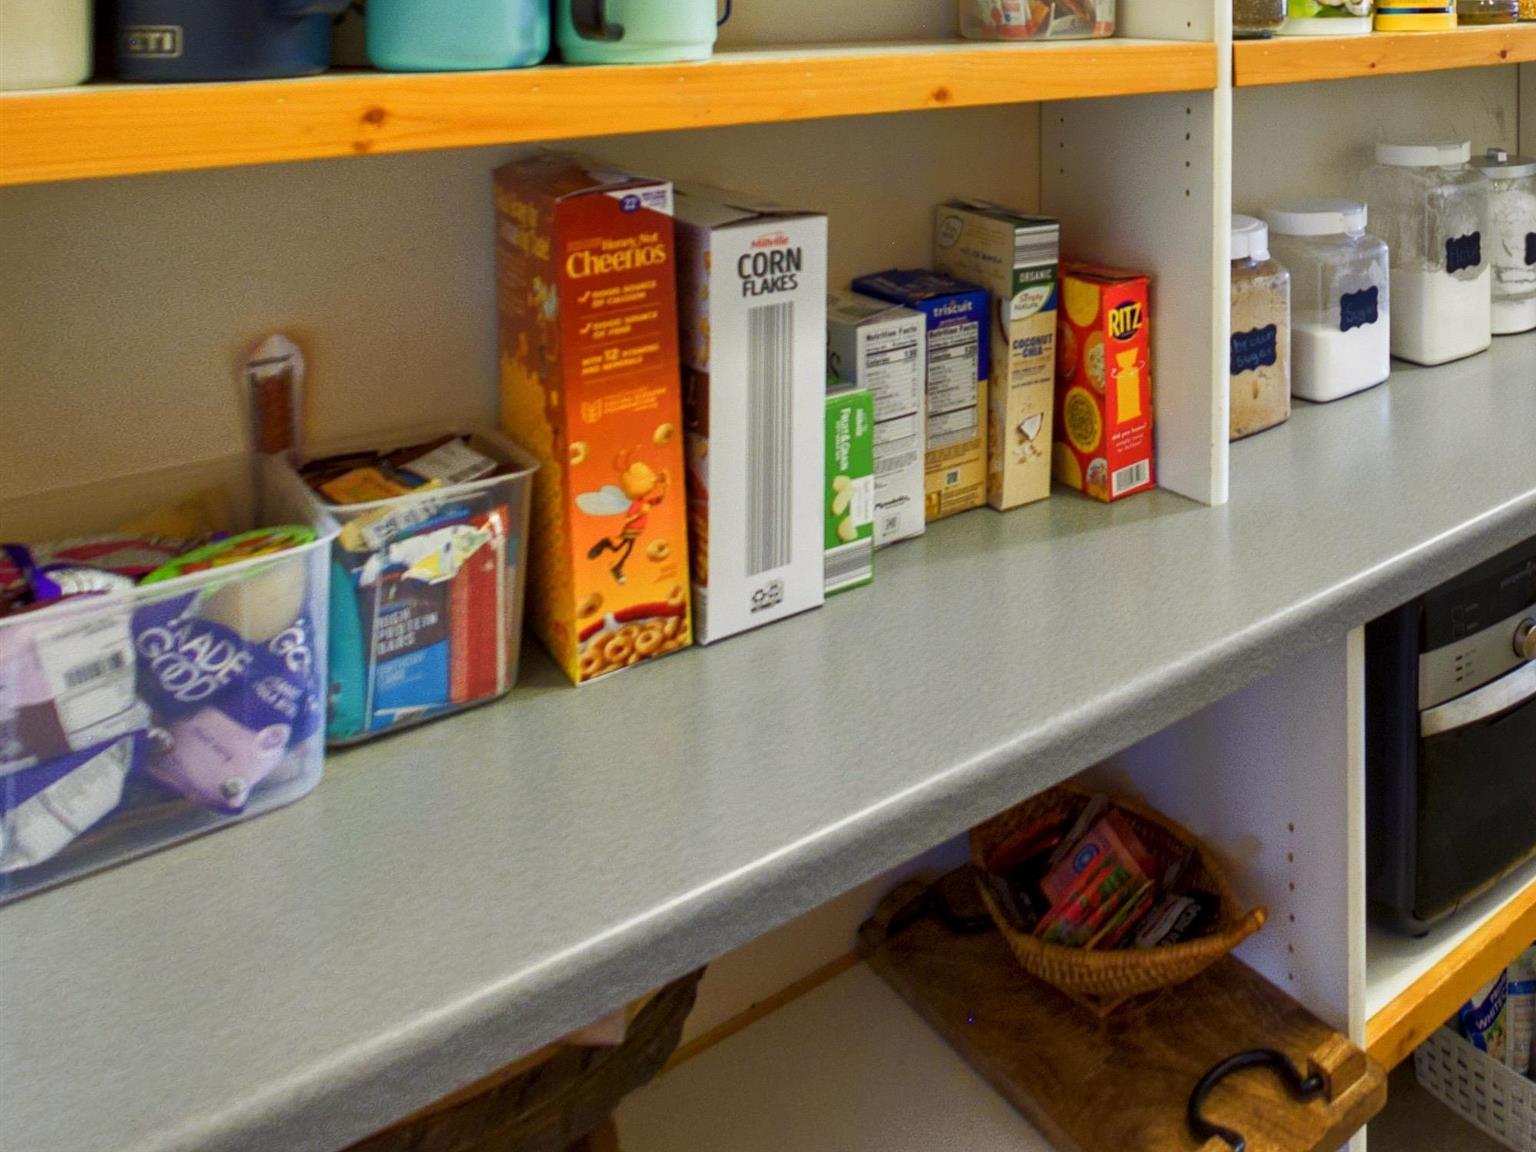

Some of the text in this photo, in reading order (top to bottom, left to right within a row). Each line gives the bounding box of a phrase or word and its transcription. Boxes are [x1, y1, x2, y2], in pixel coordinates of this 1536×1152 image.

[565, 243, 667, 279] Cheerios
[737, 246, 803, 279] CORN
[742, 273, 799, 298] FLAKES
[1019, 268, 1053, 282] ORGANIC
[933, 300, 974, 318] triscuit
[1108, 302, 1142, 338] RITZ
[1013, 333, 1053, 350] COCONUT
